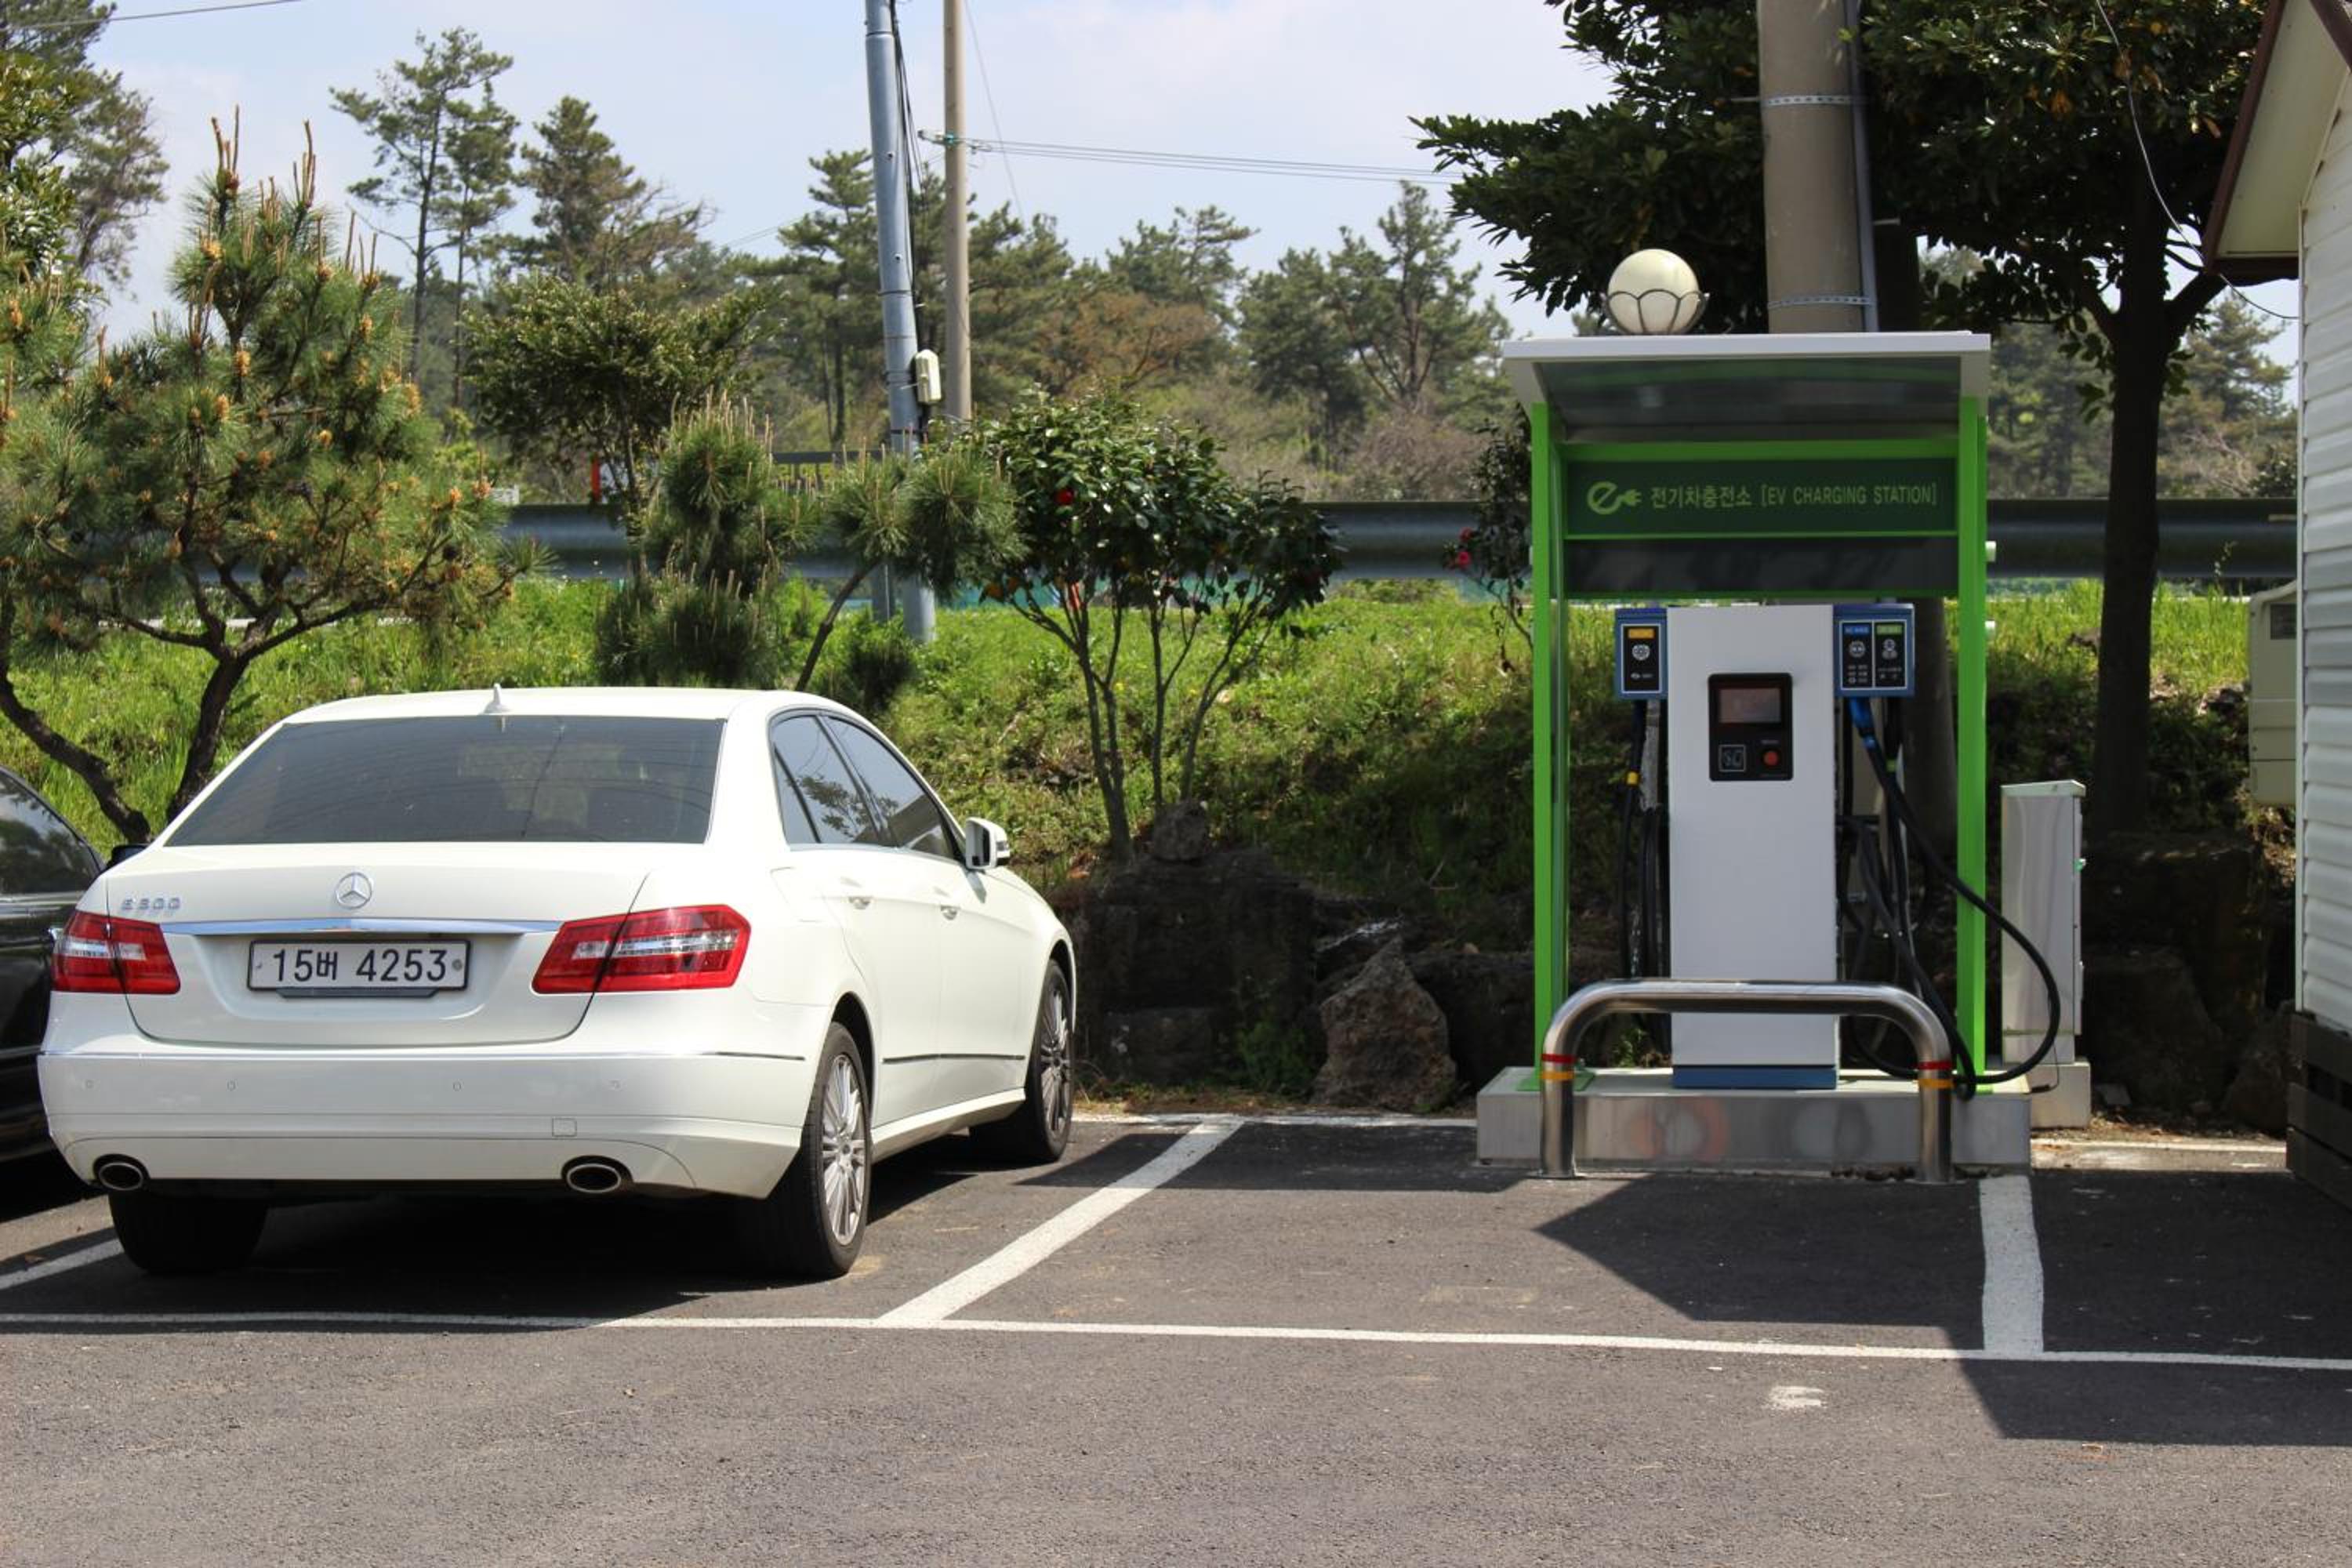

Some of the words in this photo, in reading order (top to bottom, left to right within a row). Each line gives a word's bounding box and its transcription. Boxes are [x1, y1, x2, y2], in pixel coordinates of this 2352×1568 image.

[1650, 485, 1752, 510] 전기차충전소
[1794, 485, 1867, 506] CHARGING
[273, 949, 338, 982] 15버
[355, 949, 448, 982] 4253
